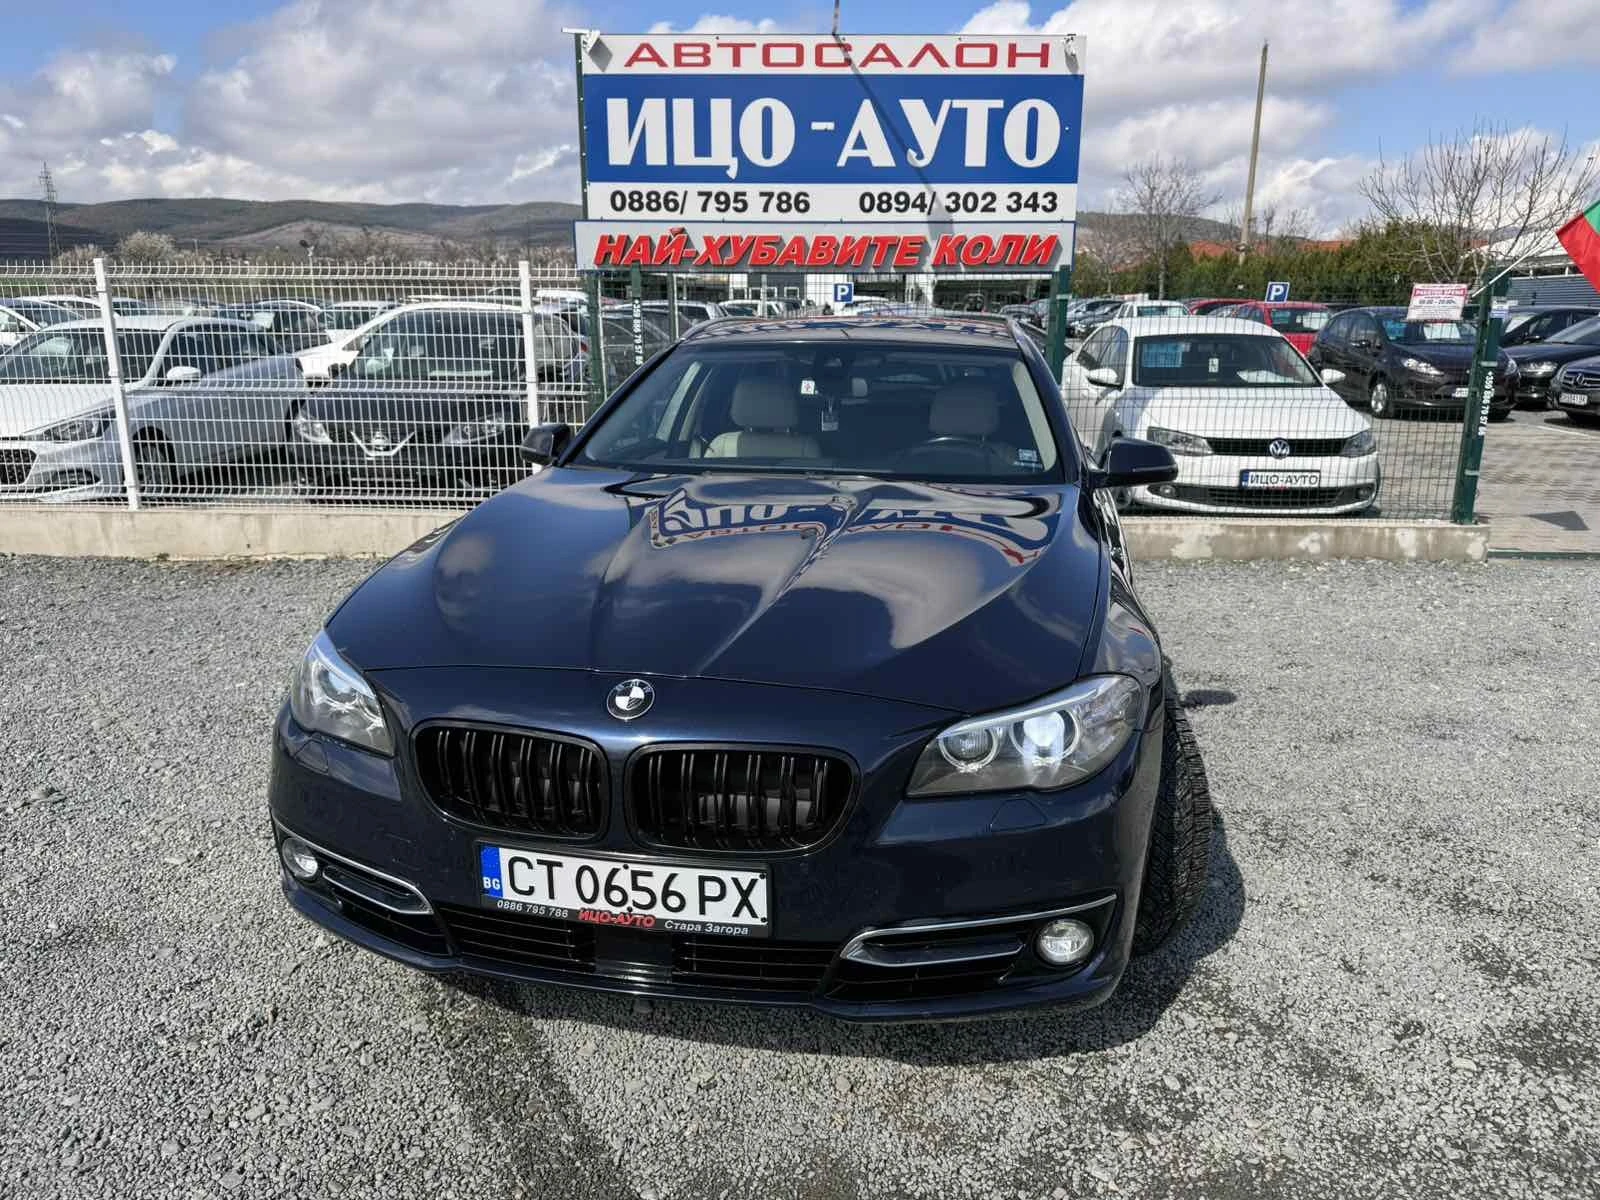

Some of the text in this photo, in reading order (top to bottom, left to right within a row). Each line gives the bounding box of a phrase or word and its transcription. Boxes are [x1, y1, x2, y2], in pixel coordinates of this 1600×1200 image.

[624, 42, 1050, 68] АВТОСАЛОН
[610, 190, 811, 215] 0886/ 795 786
[859, 191, 1058, 215] 0894/ 302 343
[593, 227, 1060, 267] НАЙ-ХУБАВИТЕ КОЛИ
[837, 285, 850, 301] P
[1270, 285, 1284, 301] P
[1250, 474, 1318, 486] ИЦО-АУТО
[482, 877, 501, 890] BG
[508, 856, 759, 919] CT 0656 PX
[497, 900, 569, 918] 0886 795 786
[578, 908, 656, 928] ИЦО-АУТО
[664, 920, 749, 936] Стара Загора
